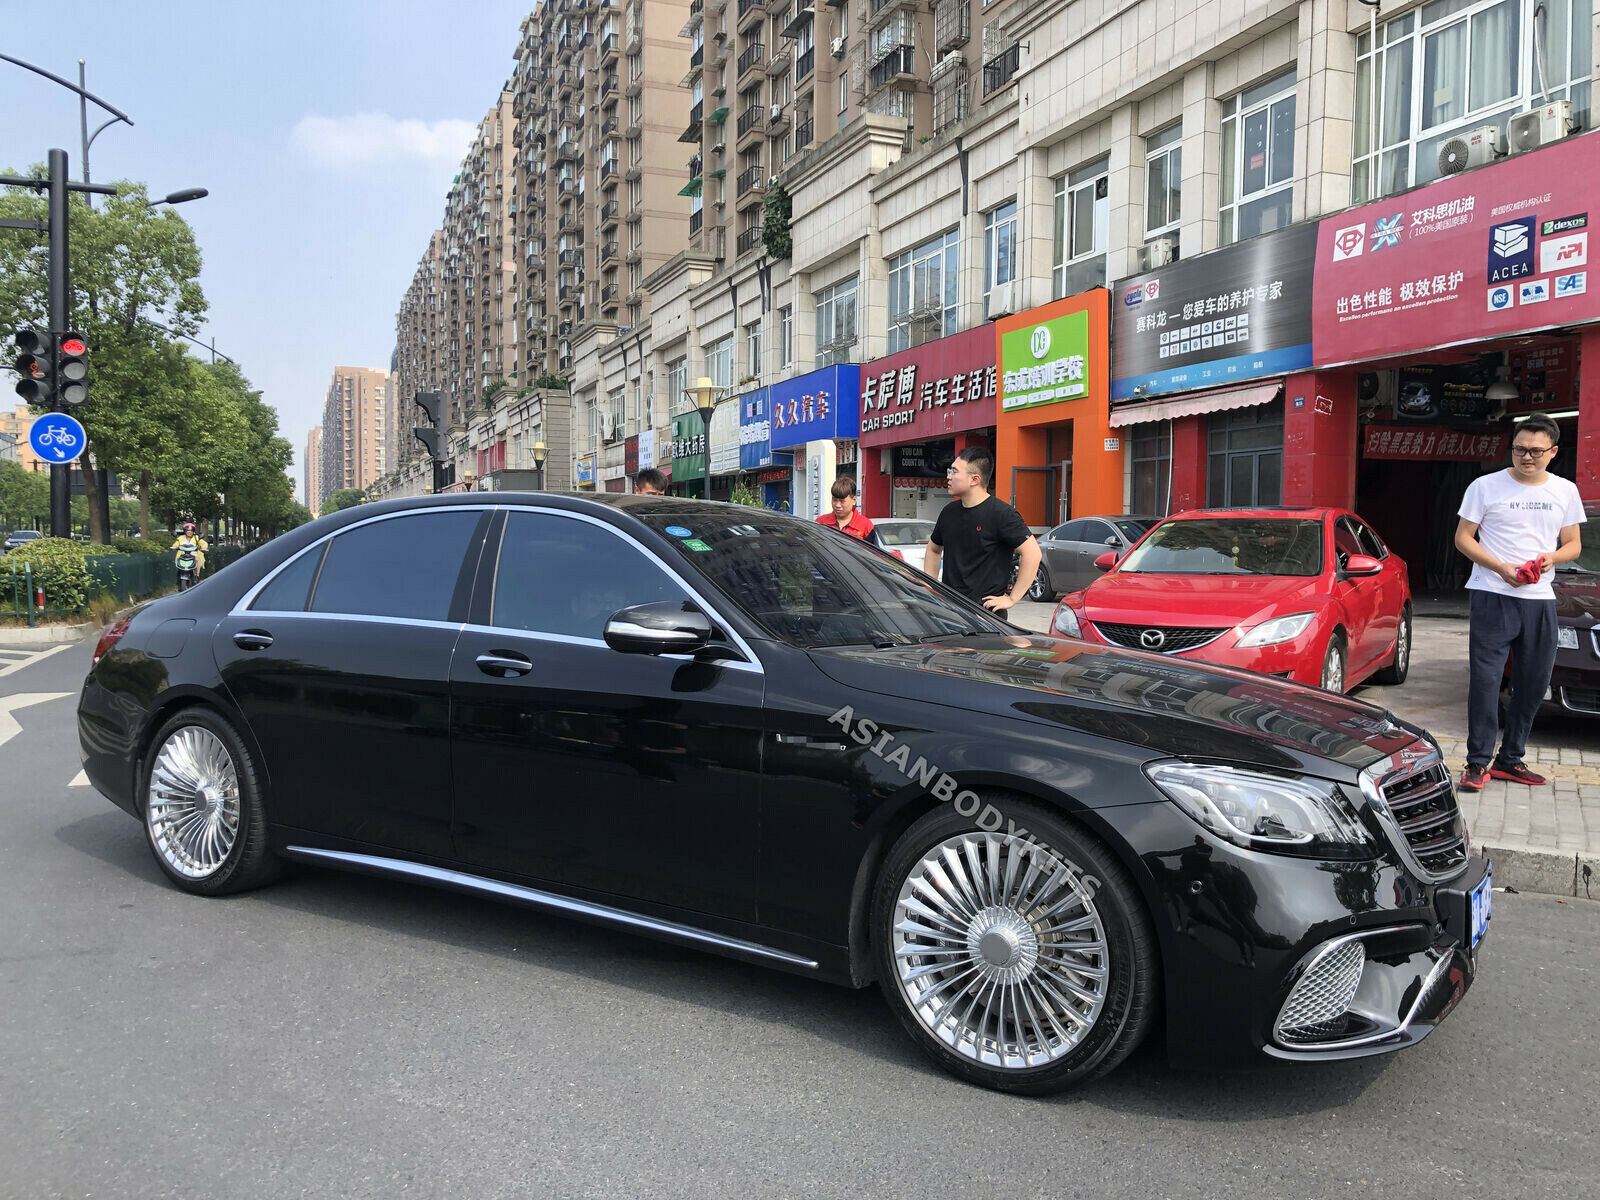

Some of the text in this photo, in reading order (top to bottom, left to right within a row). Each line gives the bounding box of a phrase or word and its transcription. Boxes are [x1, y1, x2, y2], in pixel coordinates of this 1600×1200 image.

[1410, 196, 1475, 227] 艾科思机油
[1492, 263, 1528, 281] ACEA
[1557, 274, 1583, 291] SAE
[1336, 270, 1464, 314] 出色性能 极效保护
[861, 364, 997, 414] 卡萨博 汽车生活馆
[774, 391, 829, 429] 久久汽车
[861, 409, 917, 433] CAR SPORT
